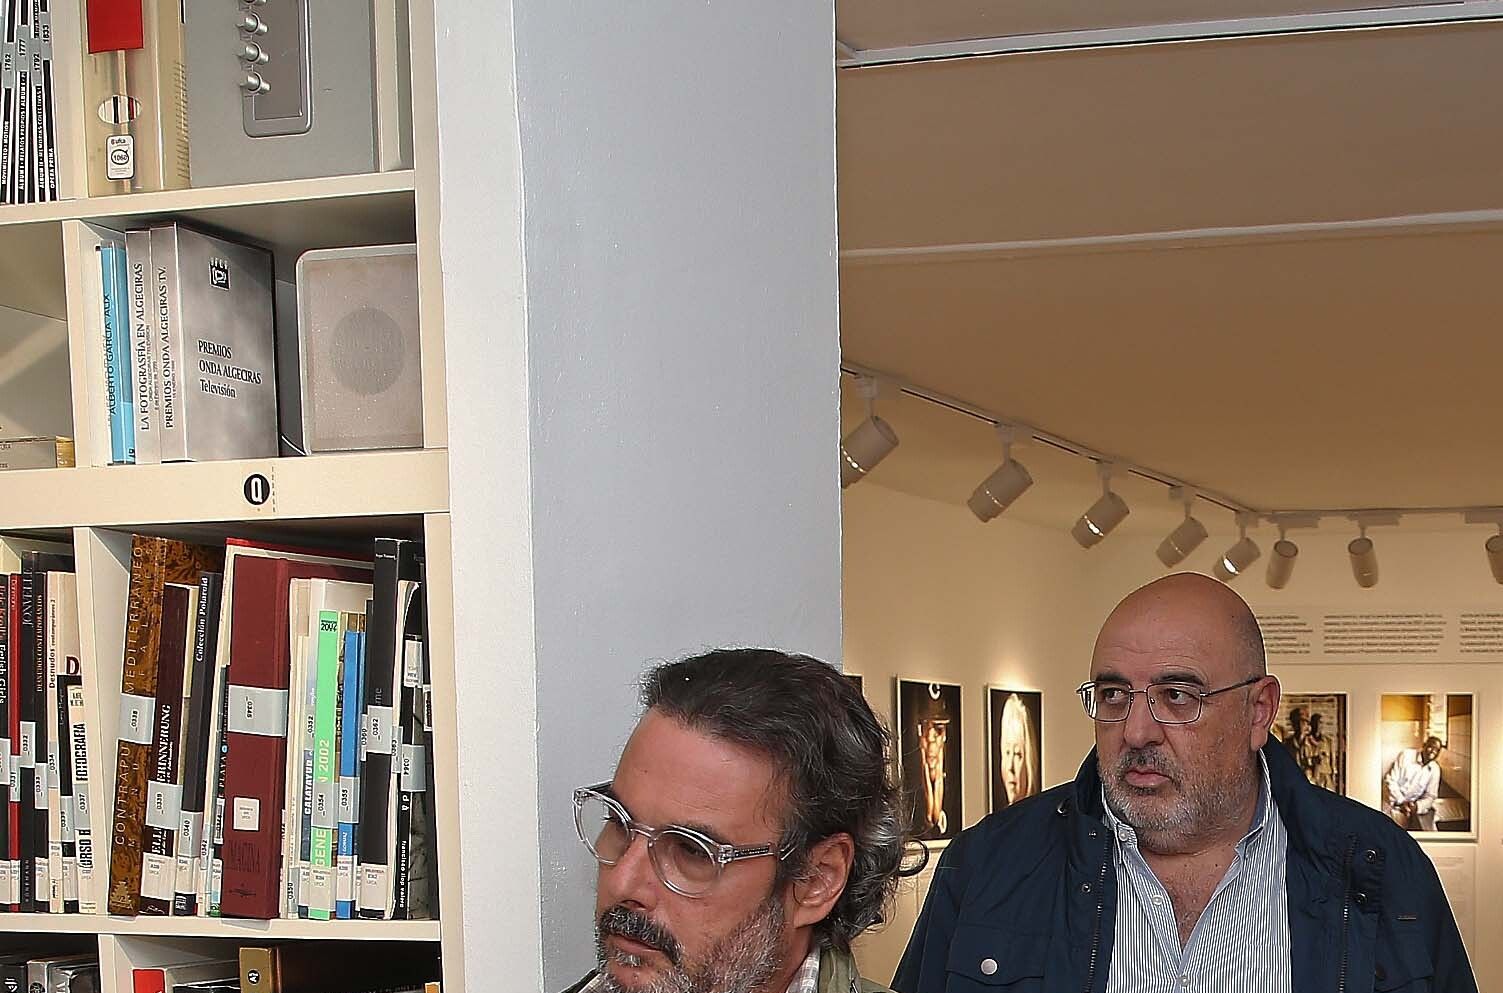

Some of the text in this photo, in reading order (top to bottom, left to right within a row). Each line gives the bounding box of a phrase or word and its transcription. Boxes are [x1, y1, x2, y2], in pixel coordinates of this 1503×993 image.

[134, 263, 145, 325] ALGECIRAS
[158, 287, 170, 347] ALGECIRAS
[135, 327, 145, 344] EN
[198, 340, 232, 358] PREMIOS
[160, 347, 171, 376] ONDA
[199, 360, 261, 385] ONDA ALGECIRAS
[161, 378, 173, 429] PREMIOS
[199, 379, 237, 399] Televisión
[140, 416, 150, 431] LA
[124, 546, 143, 693] MEDITERRANEO
[195, 577, 209, 662] Colección Polaroid
[74, 723, 89, 782] FOTOGRAFIA
[319, 739, 330, 773] 2002
